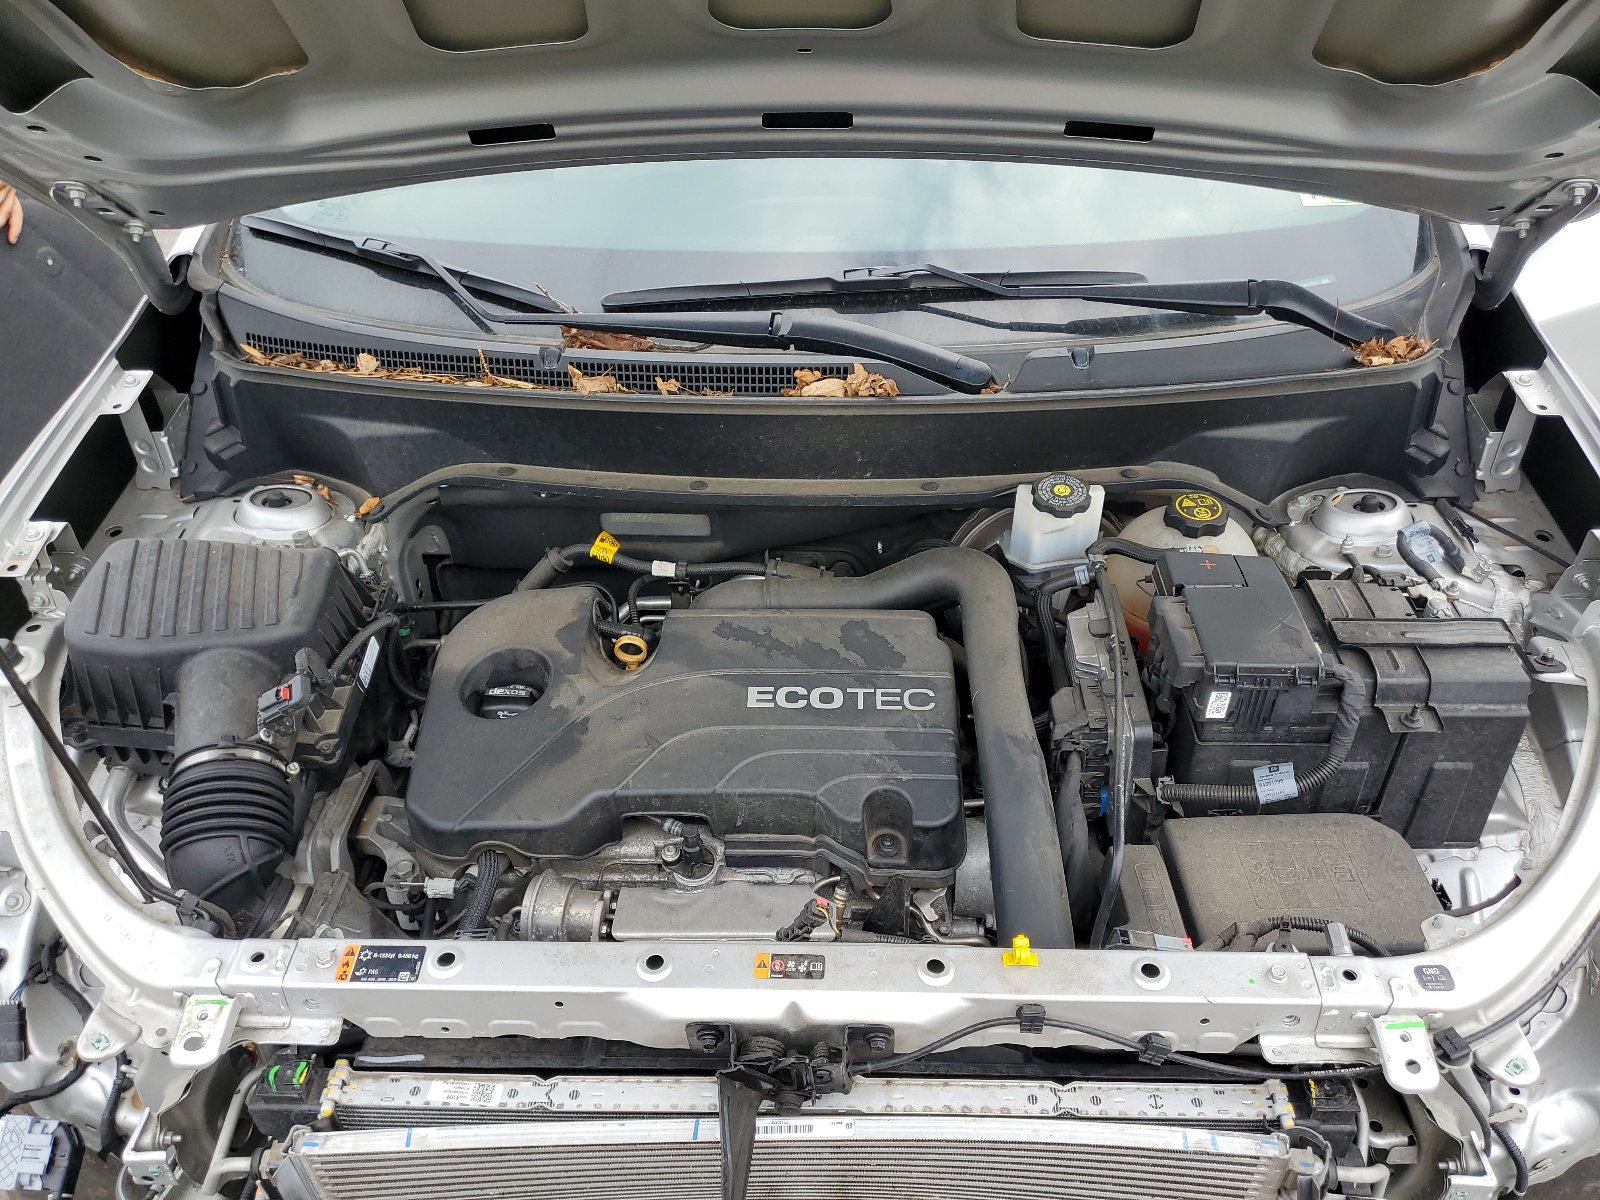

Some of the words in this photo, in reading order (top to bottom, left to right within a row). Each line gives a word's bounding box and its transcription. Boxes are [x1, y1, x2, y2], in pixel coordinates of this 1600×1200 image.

[488, 687, 527, 696] dexos
[746, 686, 936, 711] ECOTEC
[1422, 967, 1440, 975] GND
